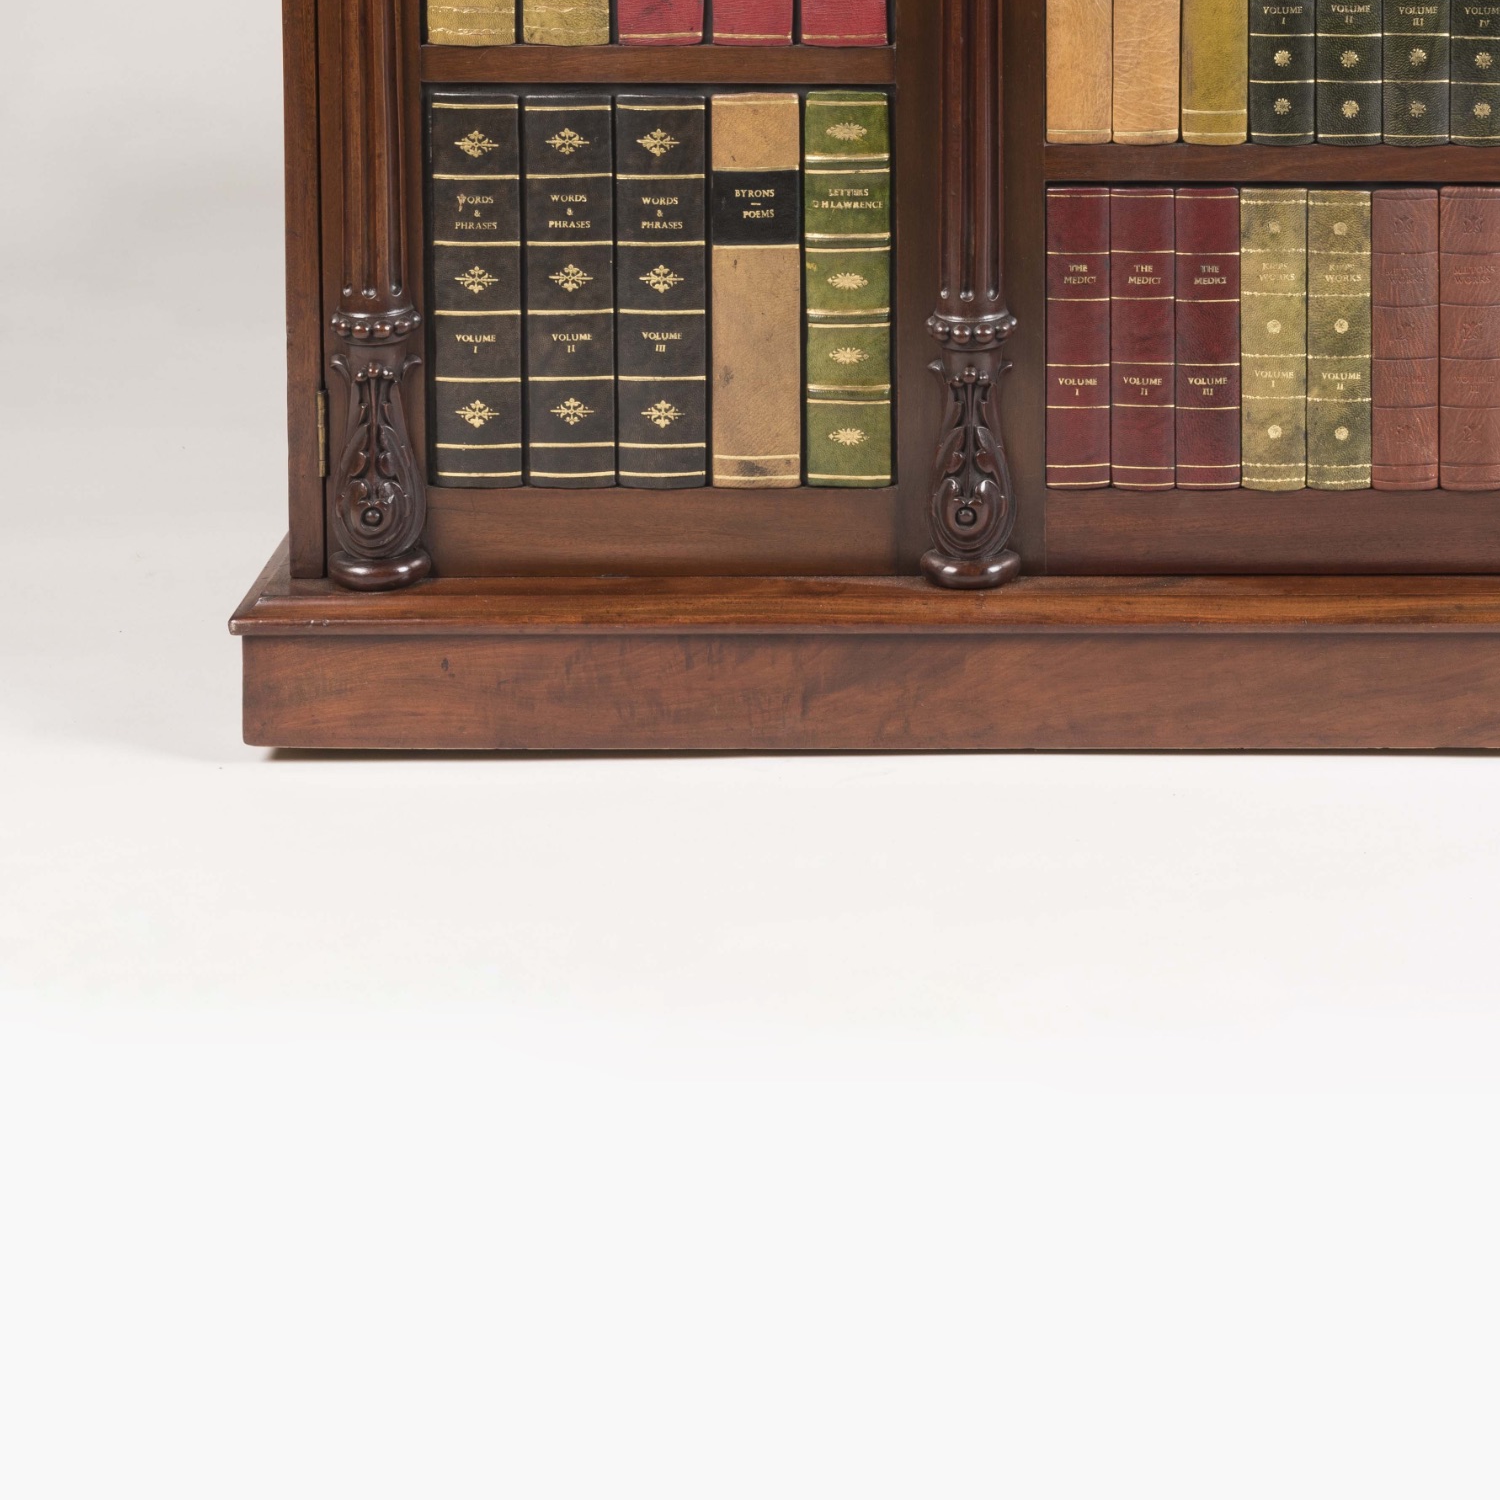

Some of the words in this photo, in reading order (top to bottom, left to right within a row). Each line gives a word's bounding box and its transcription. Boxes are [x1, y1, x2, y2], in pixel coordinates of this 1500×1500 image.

[1263, 6, 1303, 15] VOLUME
[1331, 4, 1371, 13] VOLUME
[1398, 6, 1439, 14] VOLUME
[1281, 16, 1286, 25] I
[1345, 15, 1353, 24] II
[1413, 18, 1424, 27] III
[1479, 19, 1490, 28] IV
[735, 189, 775, 198] BYRONS
[550, 194, 587, 203] WORDS
[642, 197, 679, 205] WORDS
[830, 201, 883, 209] LAWRENCE
[474, 209, 481, 217] &
[567, 208, 574, 216] &
[657, 209, 663, 217] &
[743, 209, 775, 219] POEMS
[455, 221, 497, 230] PHRASES
[548, 220, 591, 228] PHRASES
[641, 221, 683, 229] PHRASES
[1068, 265, 1088, 273] THE
[1134, 265, 1153, 273] THE
[1201, 265, 1220, 273] THE
[1064, 275, 1097, 284] MEDICI
[1128, 276, 1161, 285] MEDICI
[1194, 276, 1227, 285] MEDICI
[1325, 274, 1362, 283] WORKS
[455, 334, 496, 343] VOLUME
[551, 333, 592, 342] VOLUME
[642, 332, 682, 340] VOLUME
[567, 344, 575, 353] II
[655, 344, 666, 352] III
[1254, 370, 1294, 379] VOLUME
[1322, 372, 1361, 381] VOLUME
[1058, 378, 1098, 387] VOLUME
[1123, 376, 1162, 385] VOLUME
[1188, 377, 1228, 385] VOLUME
[1271, 379, 1276, 387] I
[1337, 382, 1344, 390] II
[1075, 388, 1080, 396] I
[1140, 387, 1148, 395] II
[1202, 387, 1213, 395] III
